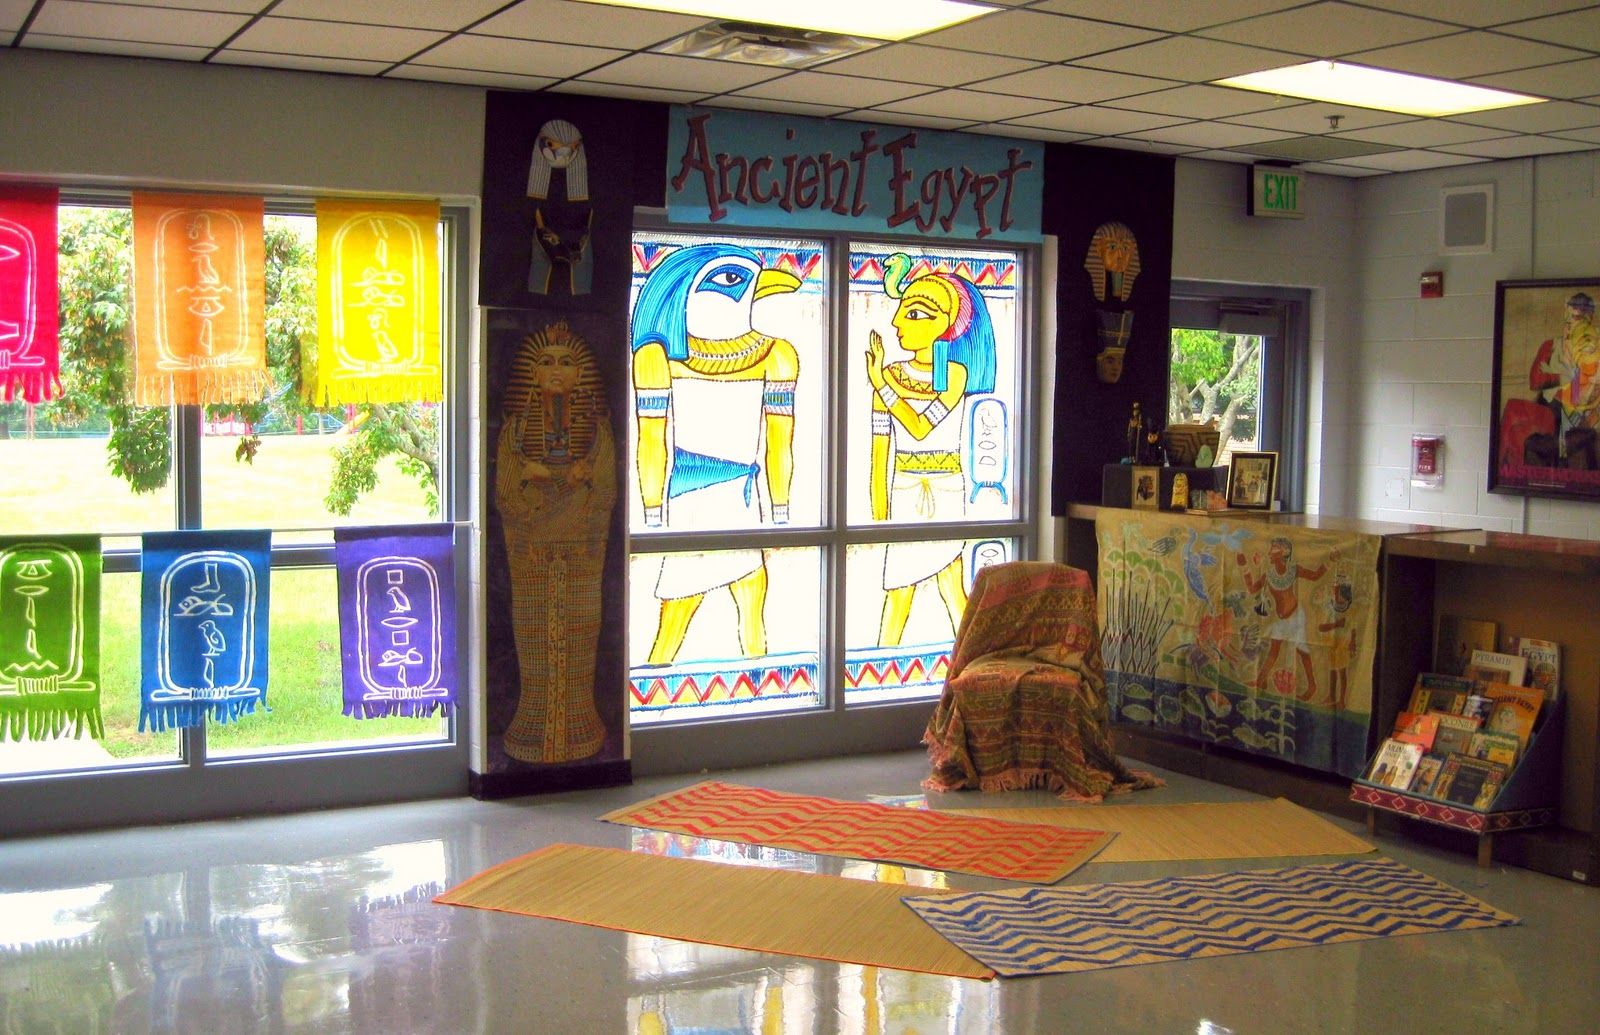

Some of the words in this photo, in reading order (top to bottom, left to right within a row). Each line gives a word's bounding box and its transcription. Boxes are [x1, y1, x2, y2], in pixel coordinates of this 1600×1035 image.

[671, 112, 881, 223] Ancient
[882, 130, 1033, 240] Egypt
[1263, 173, 1299, 210] EXIT
[1474, 651, 1512, 667] PYRAMID
[1521, 647, 1557, 664] EGYPT
